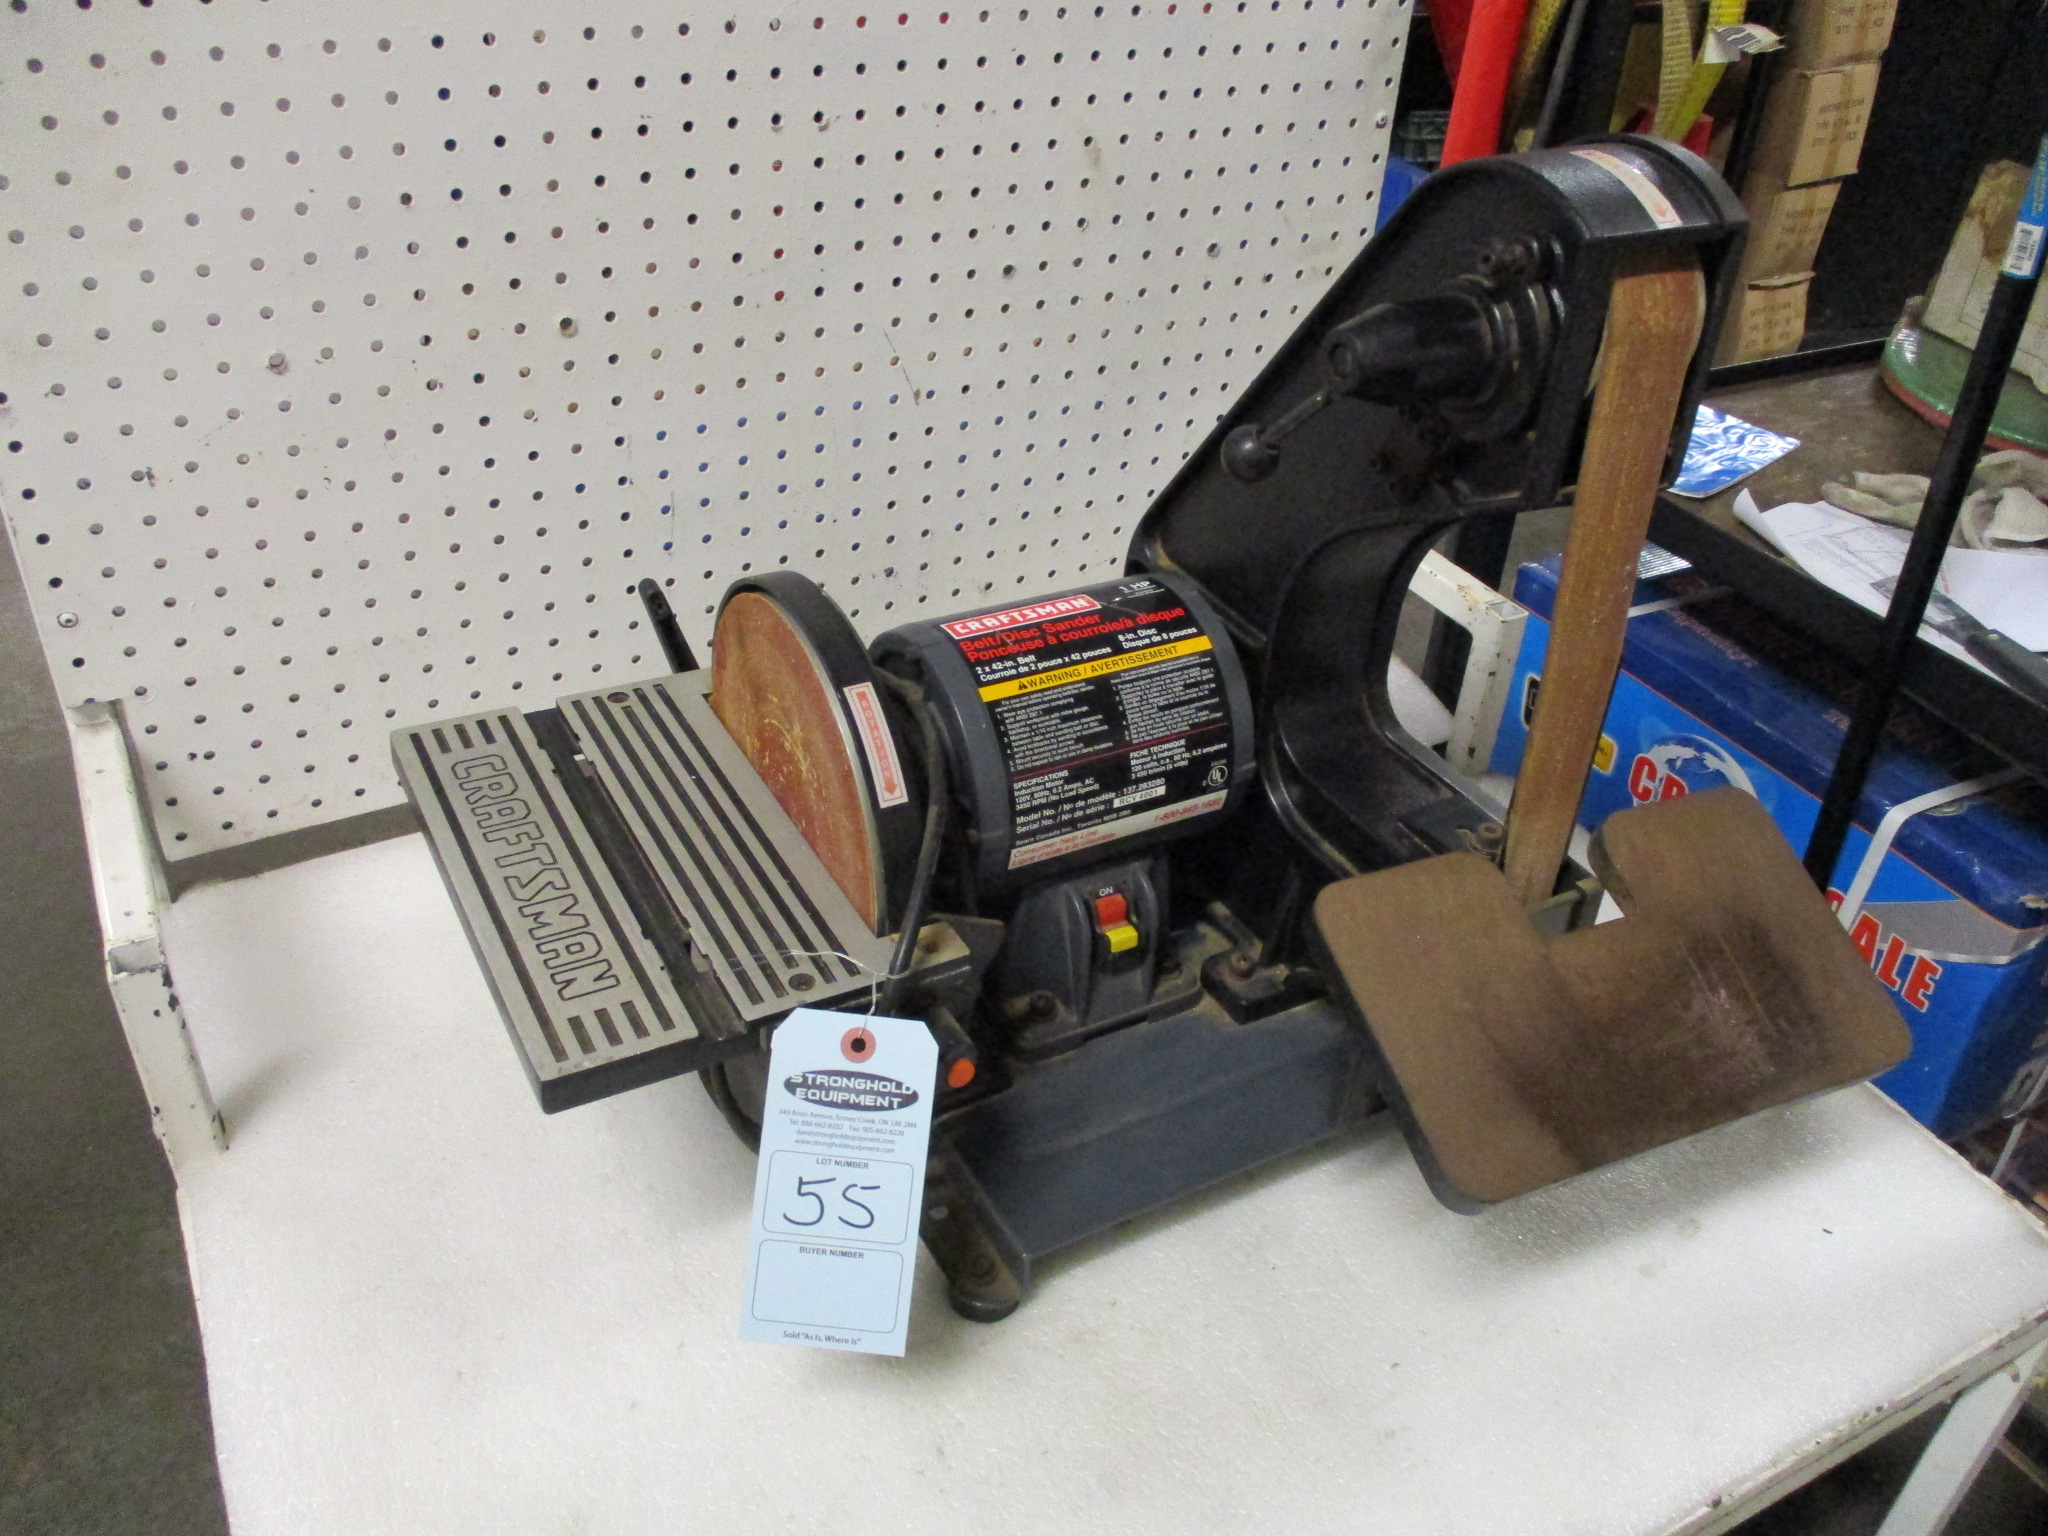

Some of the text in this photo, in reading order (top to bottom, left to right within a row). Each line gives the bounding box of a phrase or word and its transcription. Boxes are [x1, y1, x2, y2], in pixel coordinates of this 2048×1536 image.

[1130, 581, 1150, 589] HP
[954, 597, 1090, 634] CRAFTSMAN
[959, 613, 1100, 653] Belt/Disc Sander
[967, 605, 1185, 663] Ponceuse à courroie/à disque
[1122, 638, 1151, 650] Disque
[1151, 634, 1161, 642] de
[1169, 628, 1197, 639] pouces
[1137, 627, 1157, 636] Disc
[975, 666, 982, 674] 2
[992, 659, 1018, 670] 42-in.
[1018, 655, 1037, 664] Belt
[980, 668, 1017, 682] Courroie
[1030, 663, 1037, 671] 2
[1038, 659, 1062, 669] pouce
[1083, 647, 1112, 659] pouces
[1028, 669, 1081, 687] WARNING
[1090, 646, 1179, 673] AVERTISSEMENT
[1130, 739, 1186, 758] FICHE TECHNIQUE
[1130, 756, 1151, 765] Moteur
[1013, 770, 1069, 789] SPECIFICATIONS
[1014, 779, 1064, 796] Induction Motor
[1085, 777, 1094, 785] AC
[1032, 798, 1047, 806] RPM
[1061, 790, 1077, 798] Load
[1078, 784, 1100, 795] Speed)
[1016, 812, 1041, 823] Model
[1043, 808, 1056, 816] No.
[1087, 791, 1116, 804] modèle
[1016, 822, 1039, 833] Serial
[1041, 817, 1055, 826] No.
[1086, 804, 1105, 814] série
[1036, 829, 1060, 840] Canada
[451, 754, 621, 1001] CRAFTSMAN
[1099, 886, 1114, 896] ON
[790, 1073, 912, 1095] STRONGHOLD
[796, 1087, 902, 1109] EQUIPMENT
[795, 1138, 894, 1155] www.strongholdequipment.com
[816, 1158, 869, 1169] LOT NUMBER
[800, 1246, 864, 1259] BUYER NUMBER
[783, 1331, 800, 1339] Sold
[824, 1335, 850, 1344] Where
